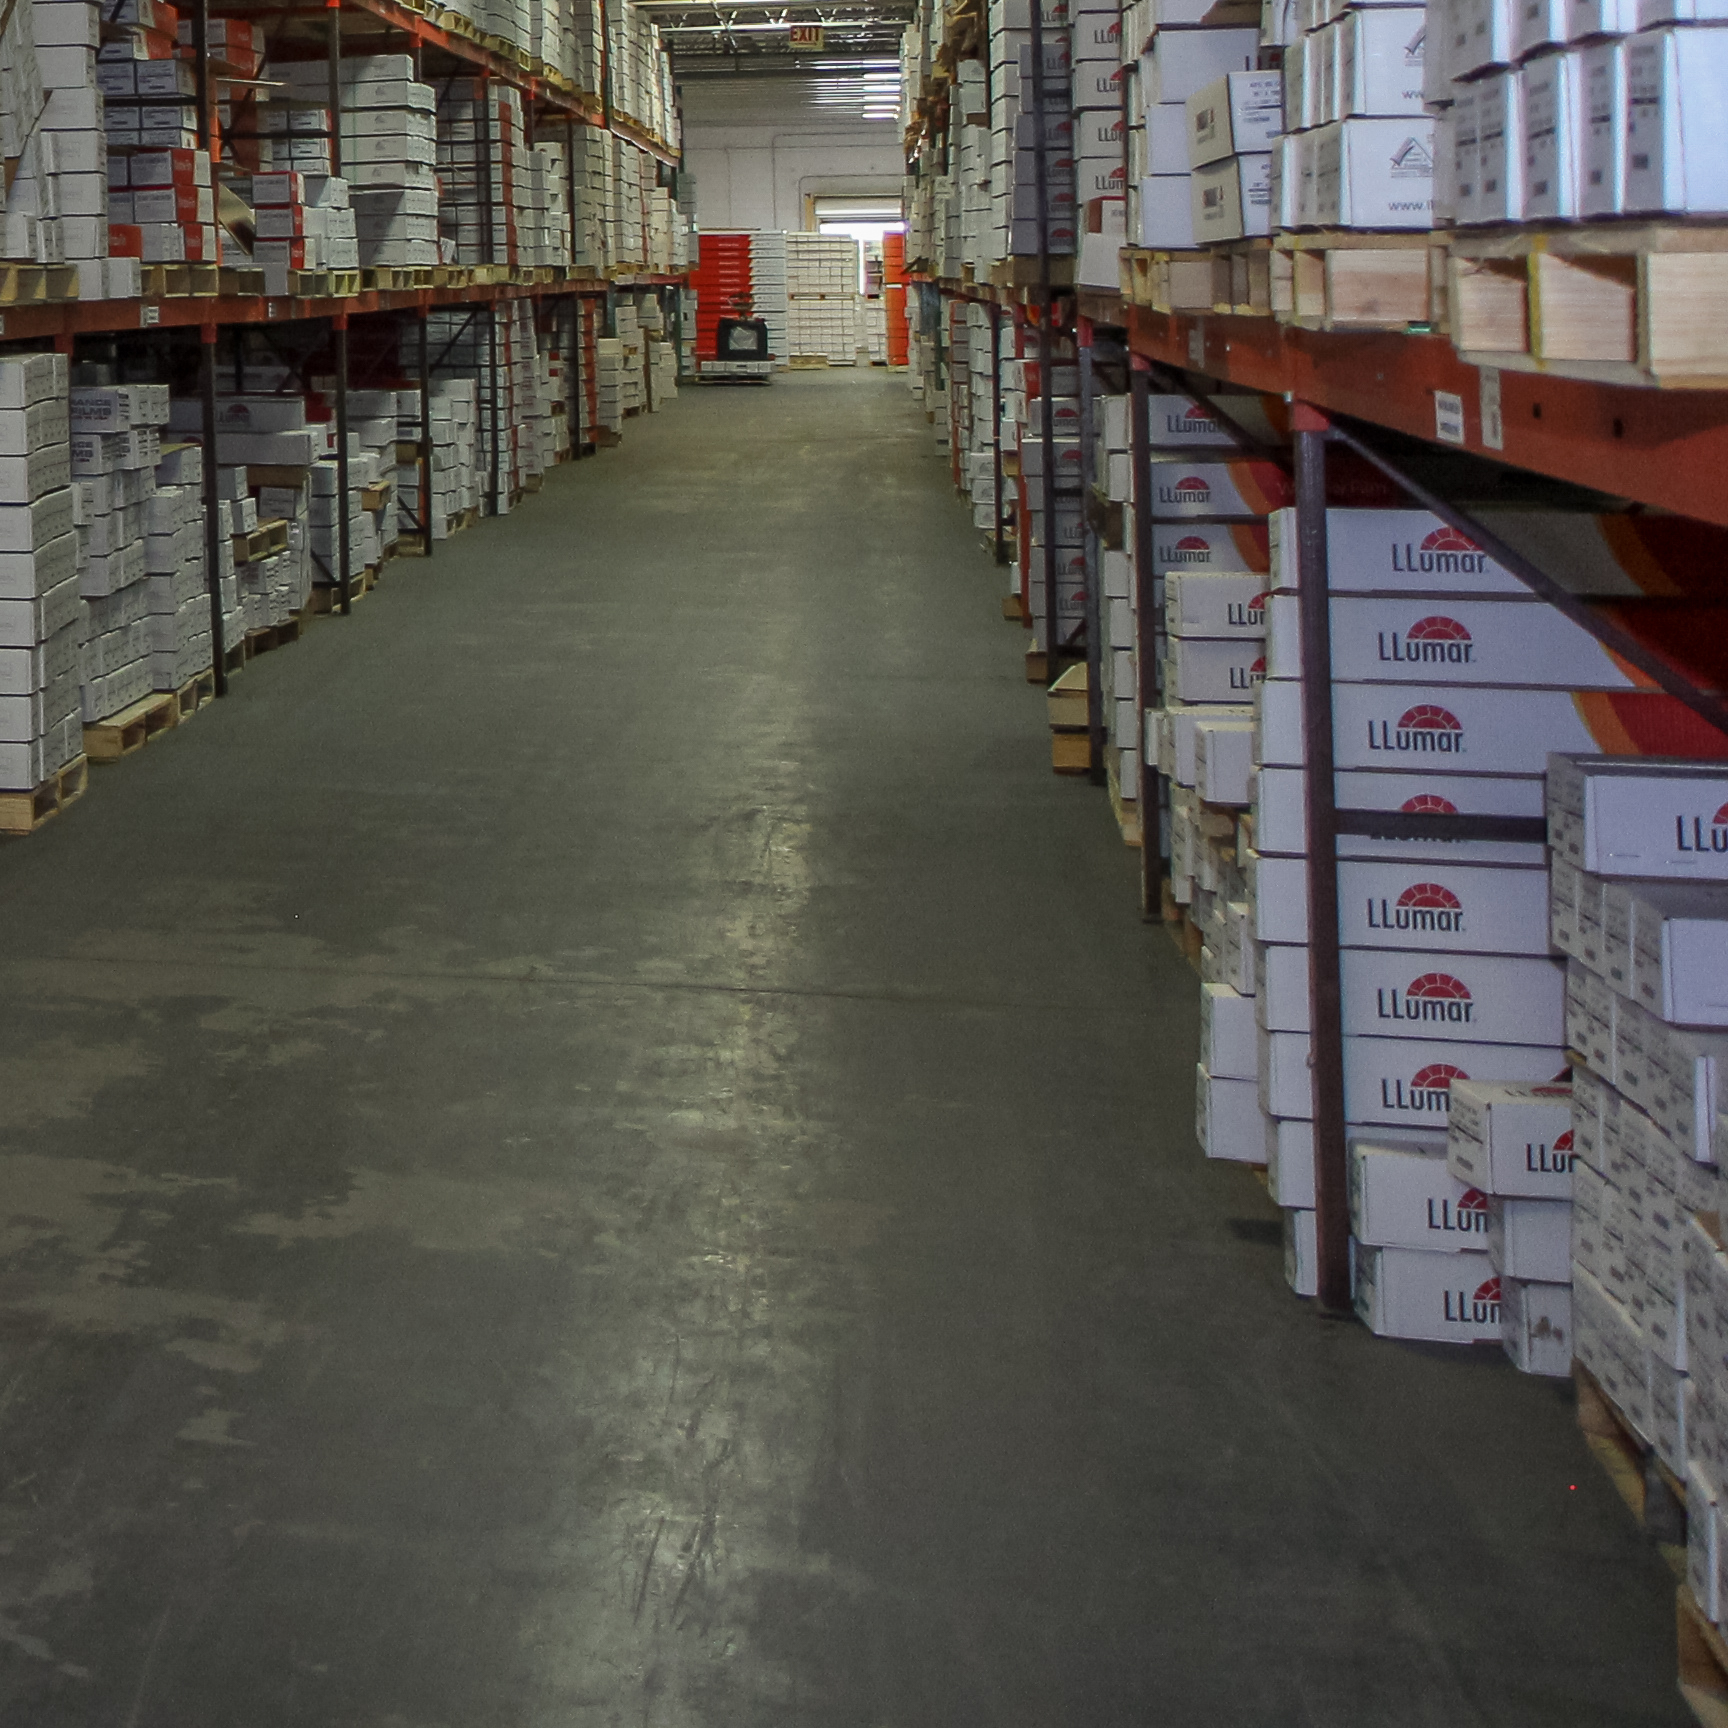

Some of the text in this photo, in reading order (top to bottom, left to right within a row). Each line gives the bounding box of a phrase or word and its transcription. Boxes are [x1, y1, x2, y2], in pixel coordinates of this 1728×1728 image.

[790, 26, 819, 42] EXIT
[1159, 486, 1211, 505] LLumar
[1159, 545, 1211, 564] LLumar
[1391, 542, 1487, 575] LLumar
[1377, 631, 1473, 664] LLumar
[1367, 720, 1463, 753] LLumar
[1367, 897, 1463, 933] LLumar
[1377, 987, 1473, 1023] LLumar
